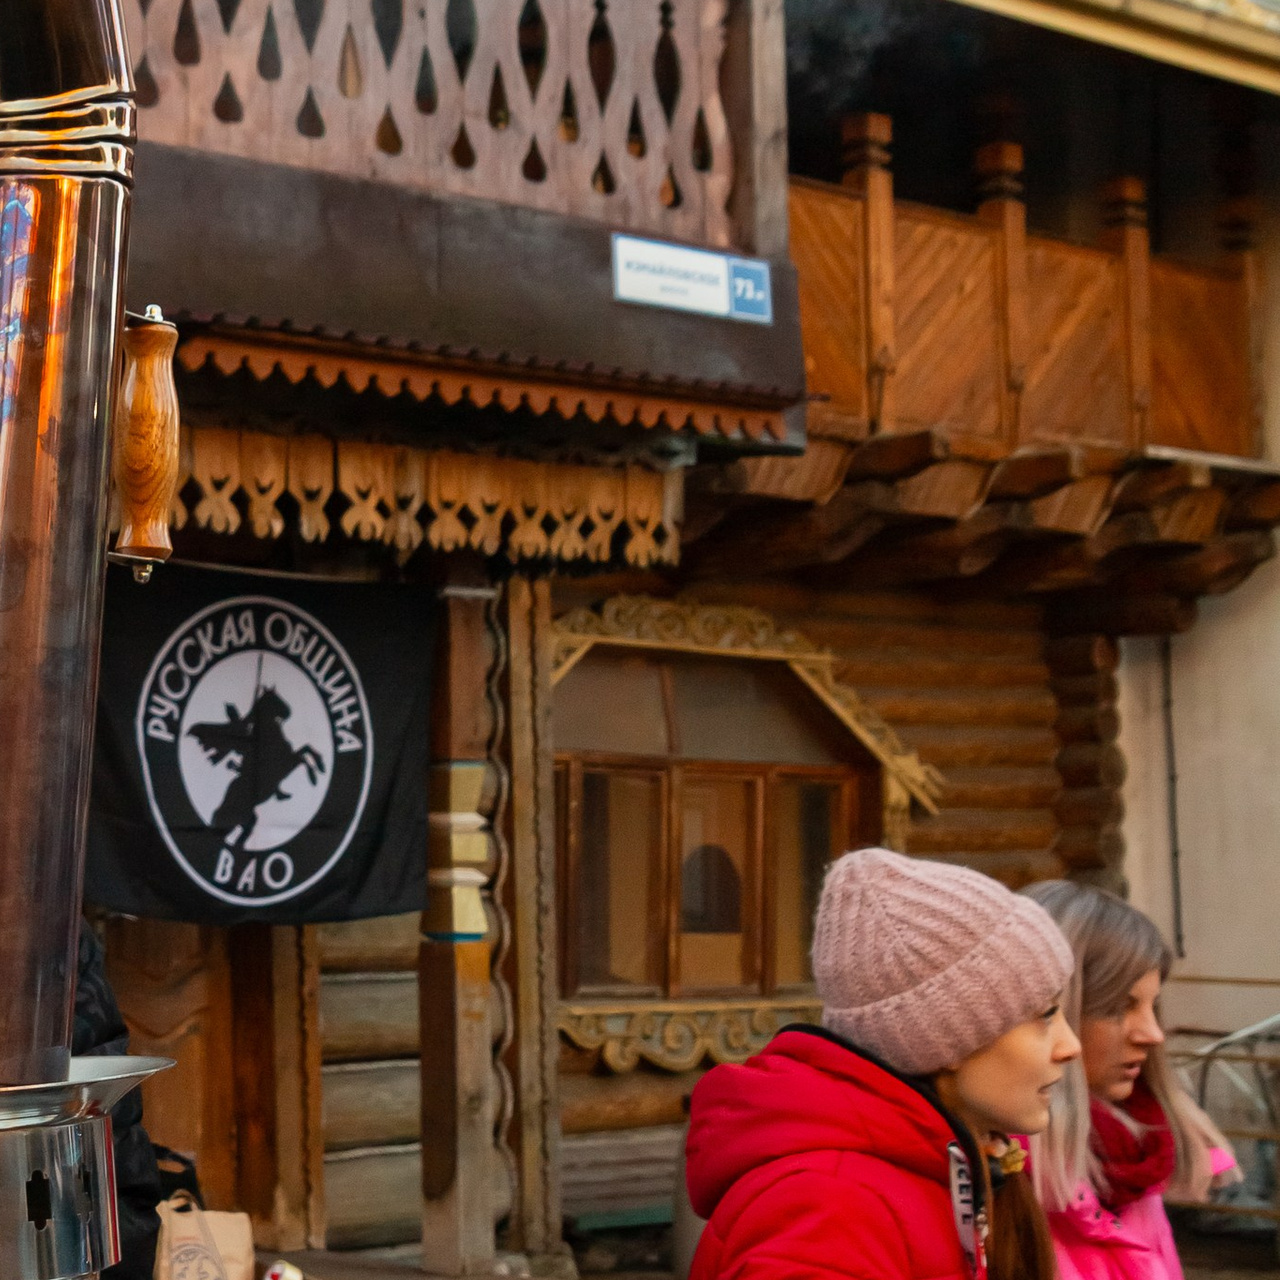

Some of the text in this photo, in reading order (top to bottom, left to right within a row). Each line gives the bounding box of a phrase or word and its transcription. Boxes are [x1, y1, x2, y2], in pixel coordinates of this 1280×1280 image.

[147, 610, 363, 754] РУССКАЯ ОБЩИНА
[214, 848, 294, 893] ВАО
